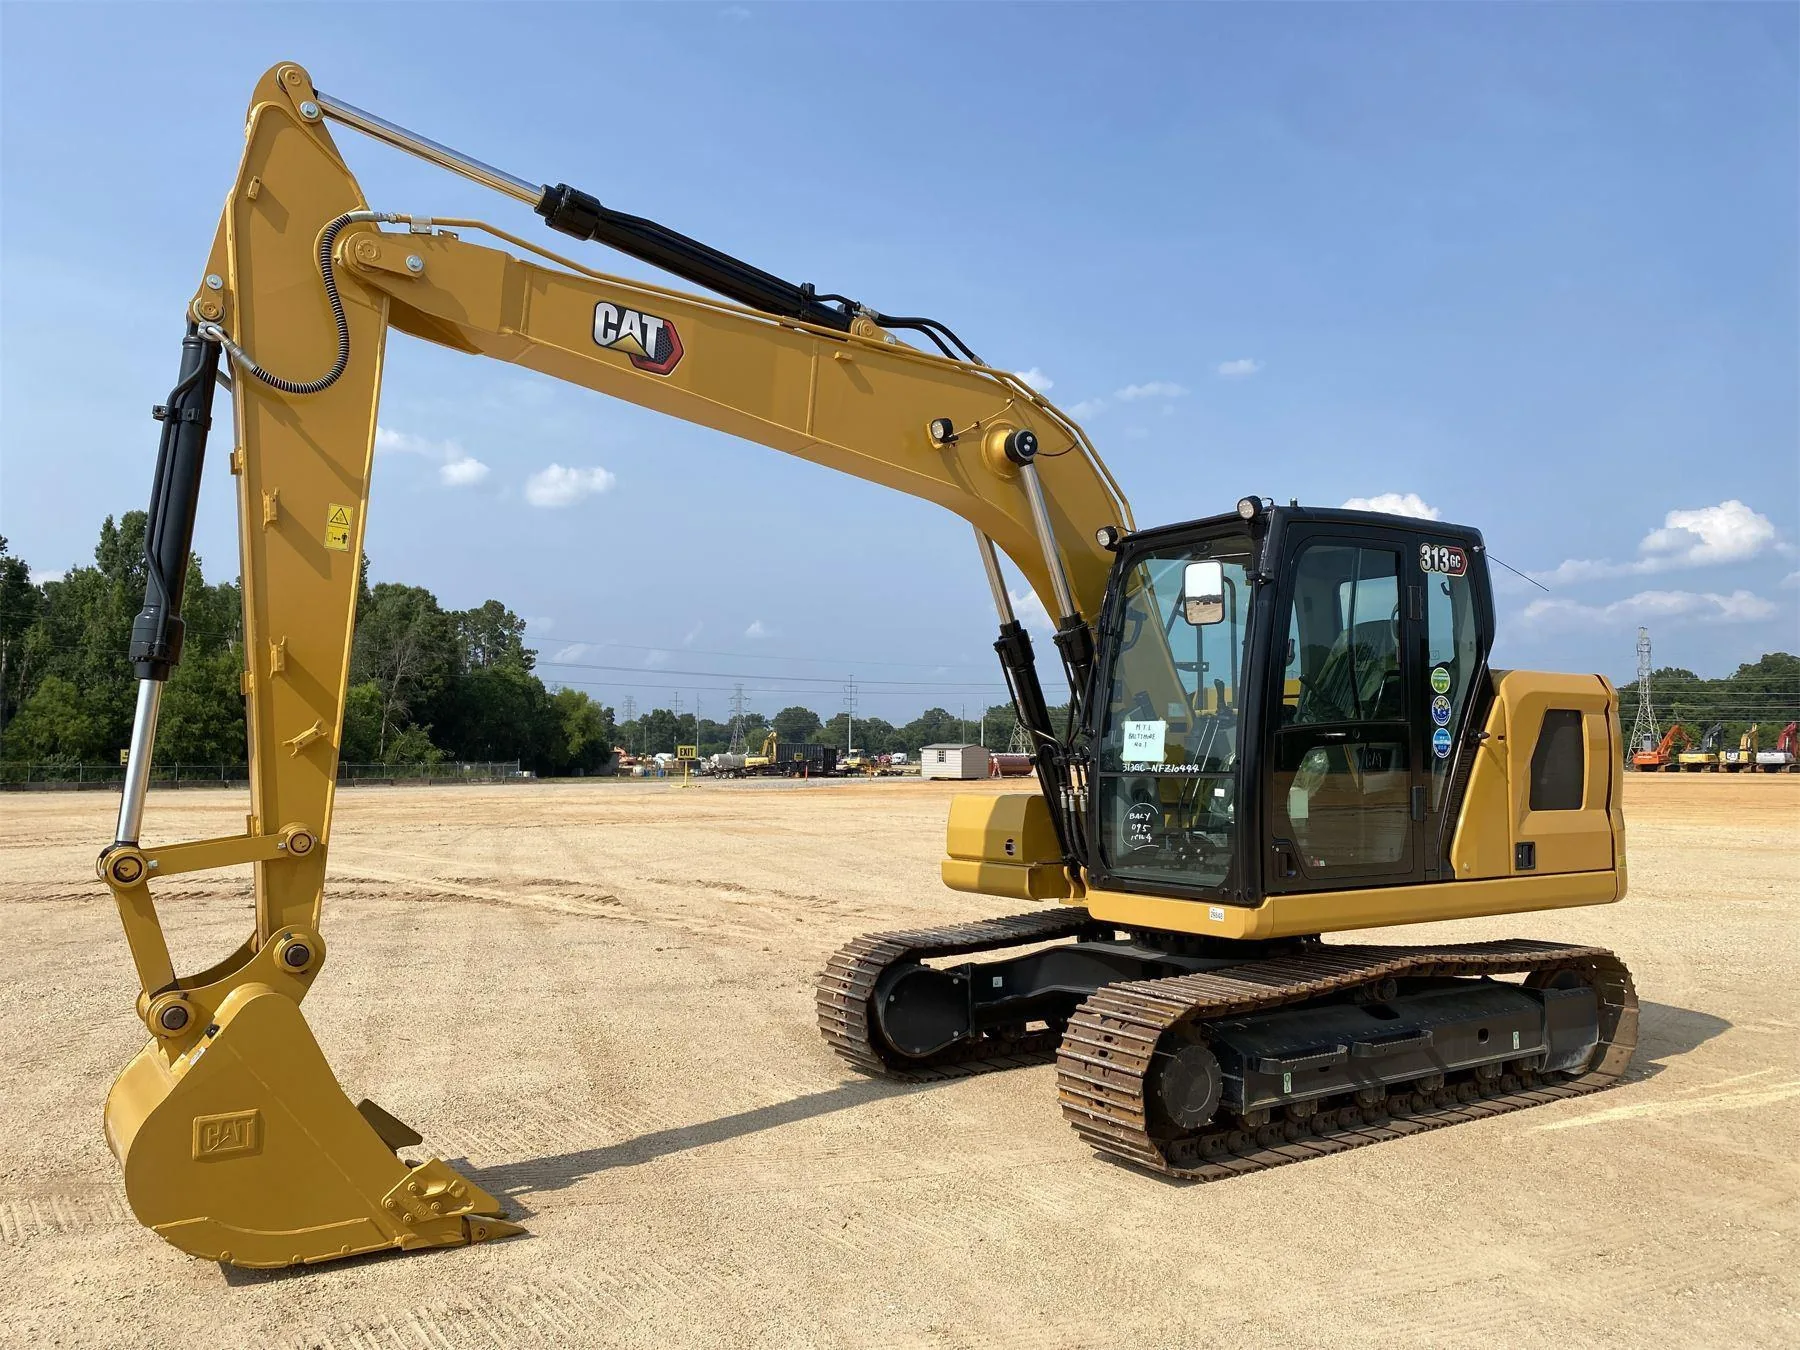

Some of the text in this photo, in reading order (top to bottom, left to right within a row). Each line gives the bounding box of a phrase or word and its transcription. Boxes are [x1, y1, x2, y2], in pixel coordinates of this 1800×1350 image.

[593, 302, 664, 359] CAT
[1421, 545, 1461, 572] 313 GC
[680, 747, 694, 757] EXIT
[200, 1118, 255, 1153] CAT
